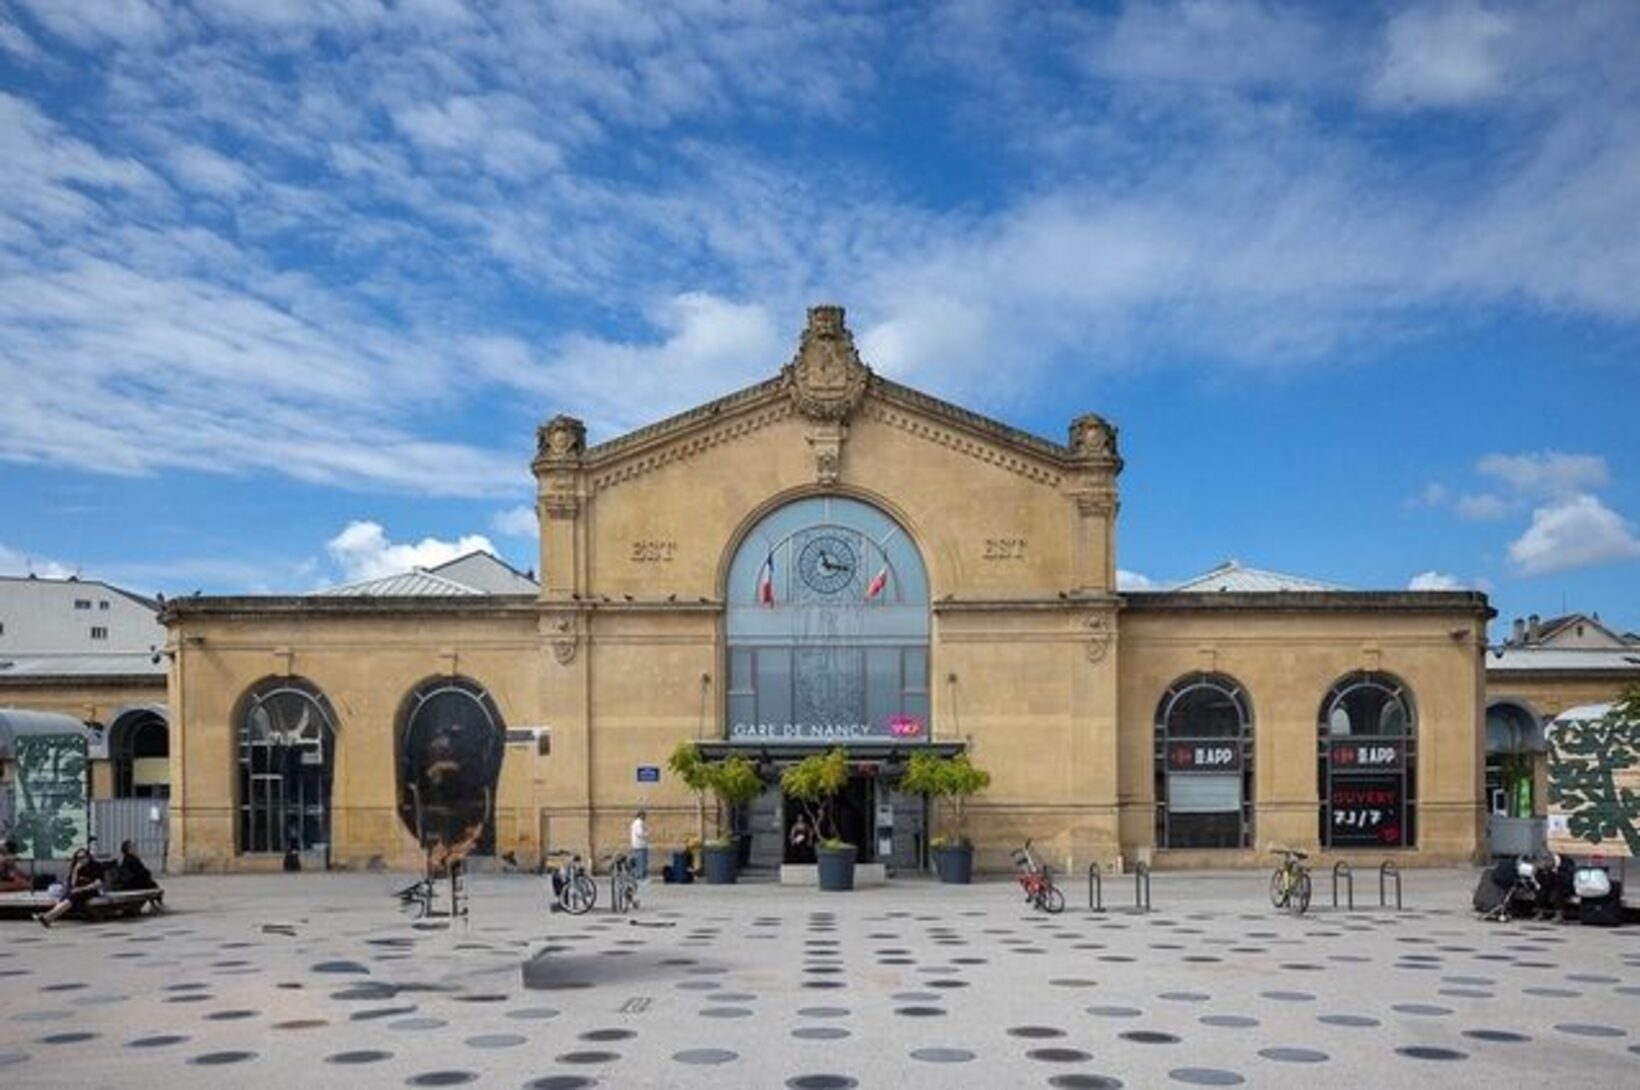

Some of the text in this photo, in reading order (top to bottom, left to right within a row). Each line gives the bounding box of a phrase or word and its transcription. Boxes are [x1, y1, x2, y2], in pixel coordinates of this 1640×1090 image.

[734, 723, 871, 736] GARE DE NANCY
